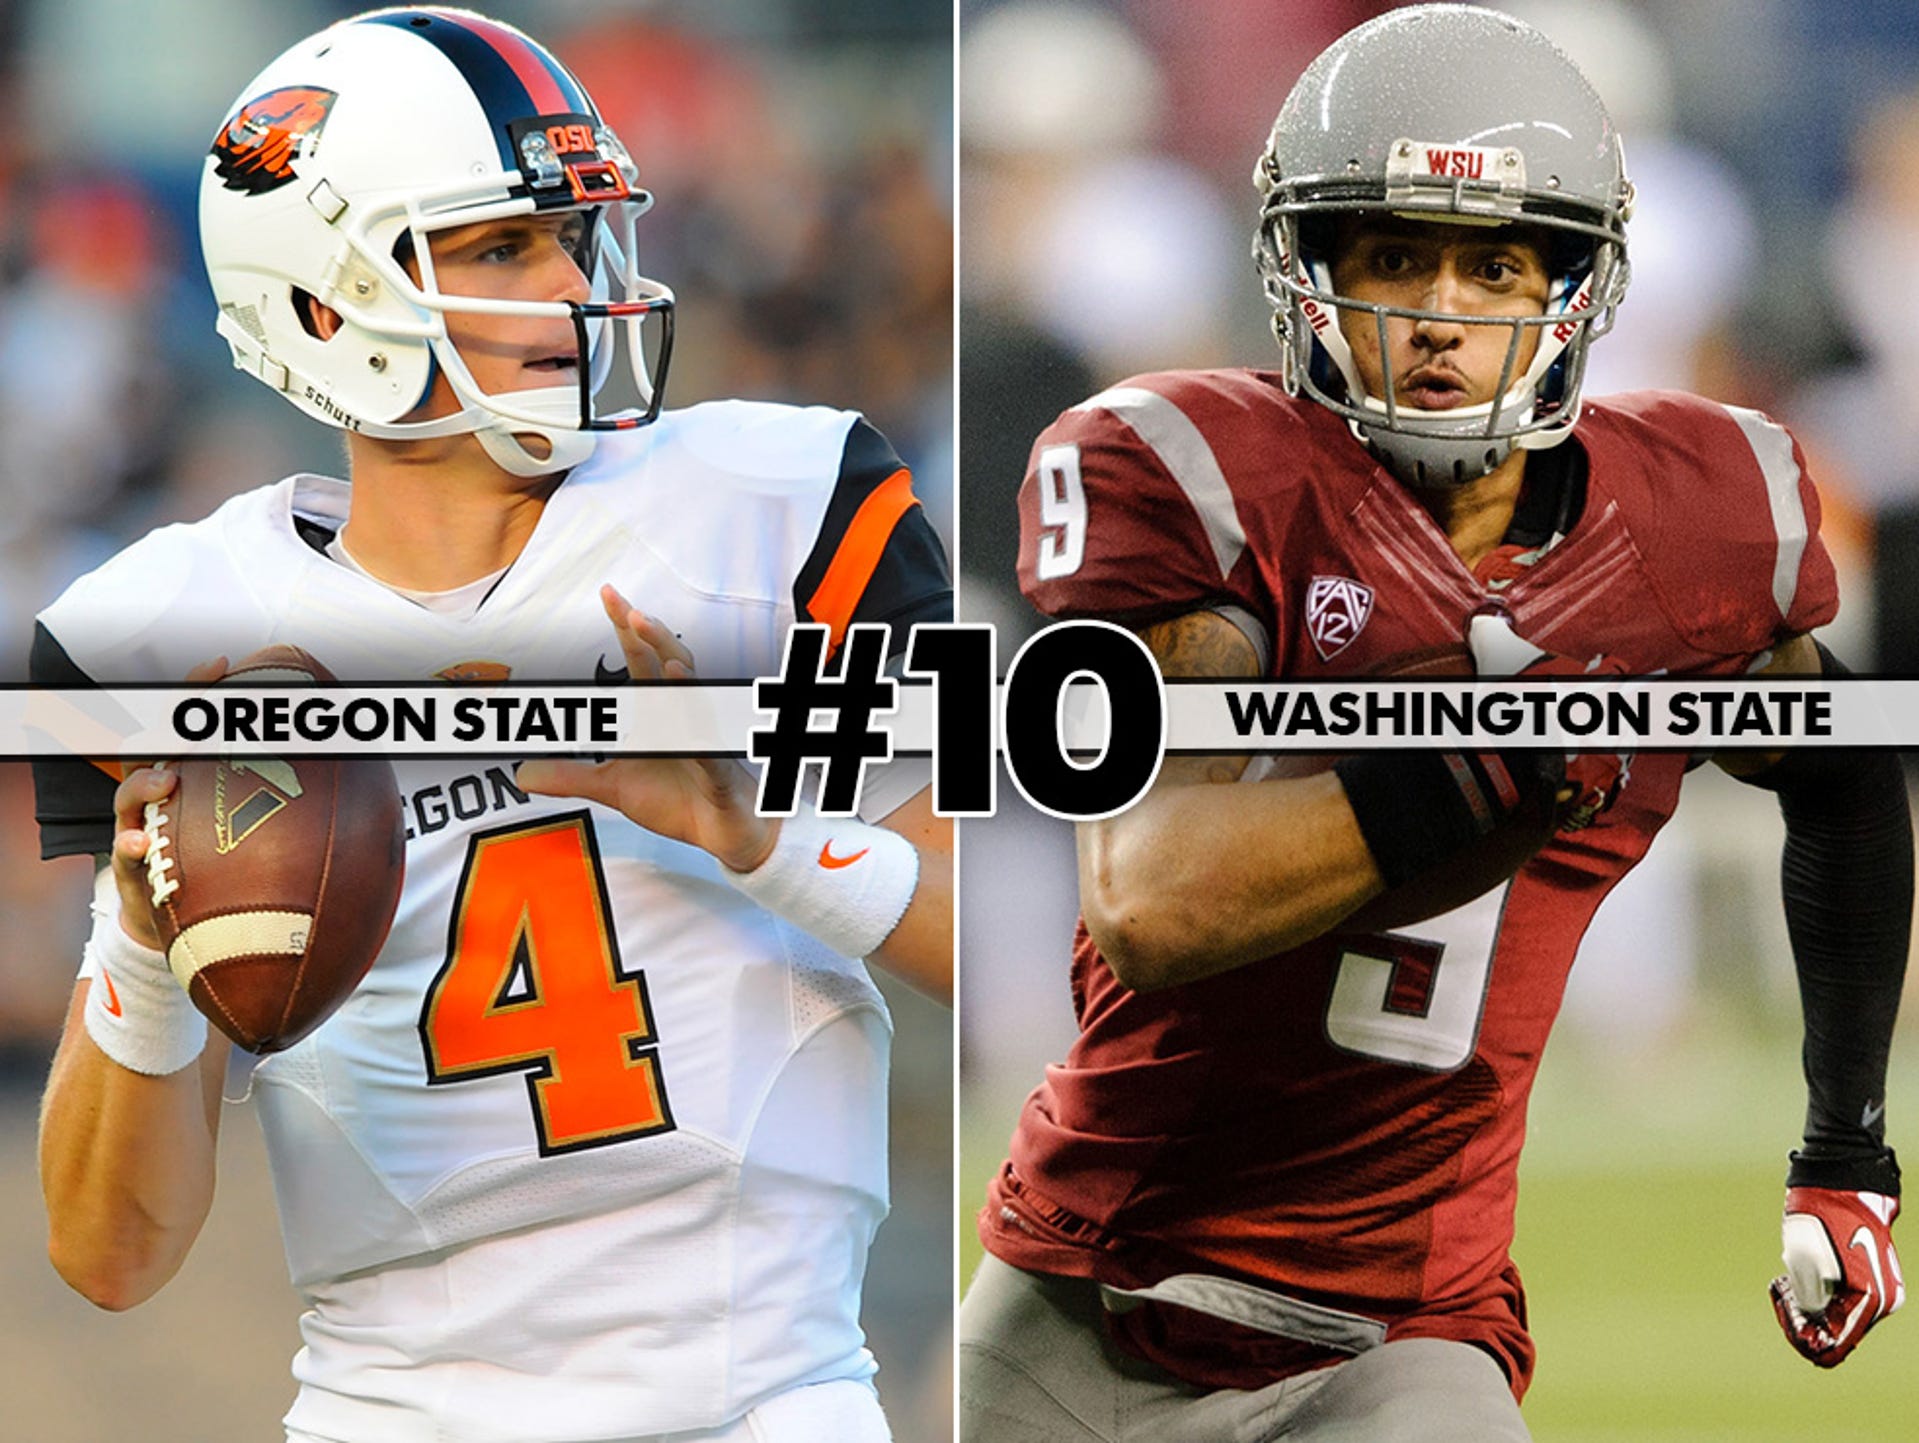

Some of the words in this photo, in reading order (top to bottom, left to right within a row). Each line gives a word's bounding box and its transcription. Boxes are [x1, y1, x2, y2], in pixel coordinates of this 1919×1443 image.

[1427, 150, 1483, 179] WSU
[305, 385, 362, 432] schutt
[1037, 444, 1087, 581] 9
[1309, 581, 1369, 632] PAC
[1317, 612, 1349, 643] 12
[417, 808, 677, 1158] 4
